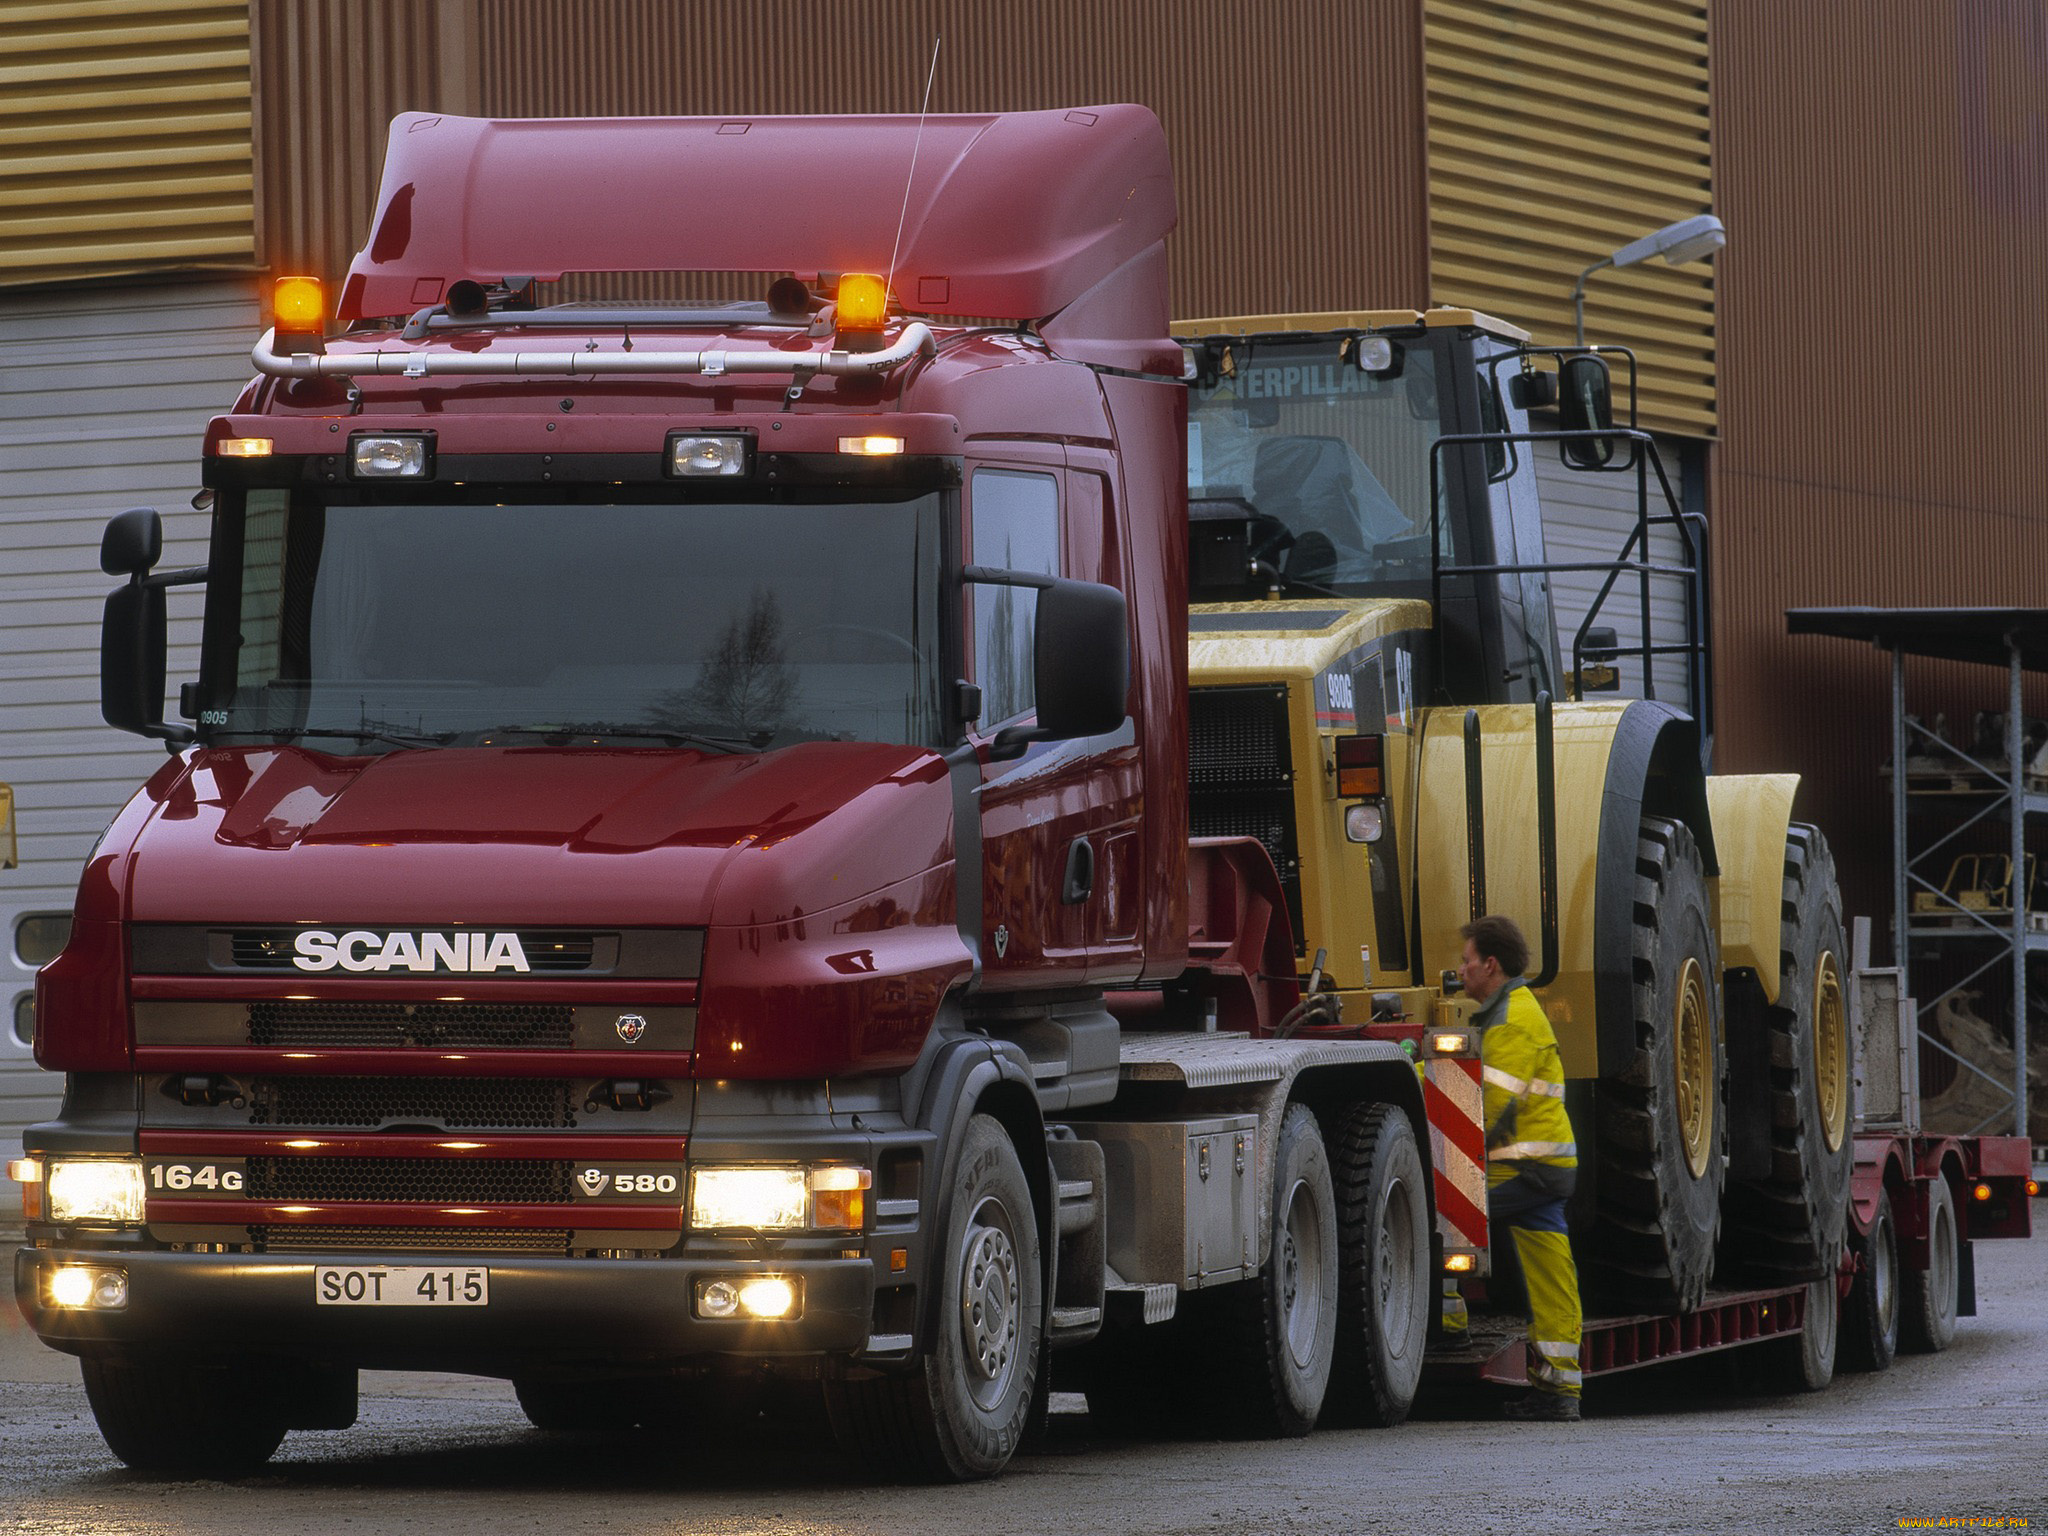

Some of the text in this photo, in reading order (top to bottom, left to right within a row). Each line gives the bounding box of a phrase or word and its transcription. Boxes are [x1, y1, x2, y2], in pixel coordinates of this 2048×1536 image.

[1328, 673, 1353, 709] 980G
[292, 930, 531, 973] SCANIA
[614, 1174, 677, 1193] 580
[322, 1271, 482, 1302] SOT 415
